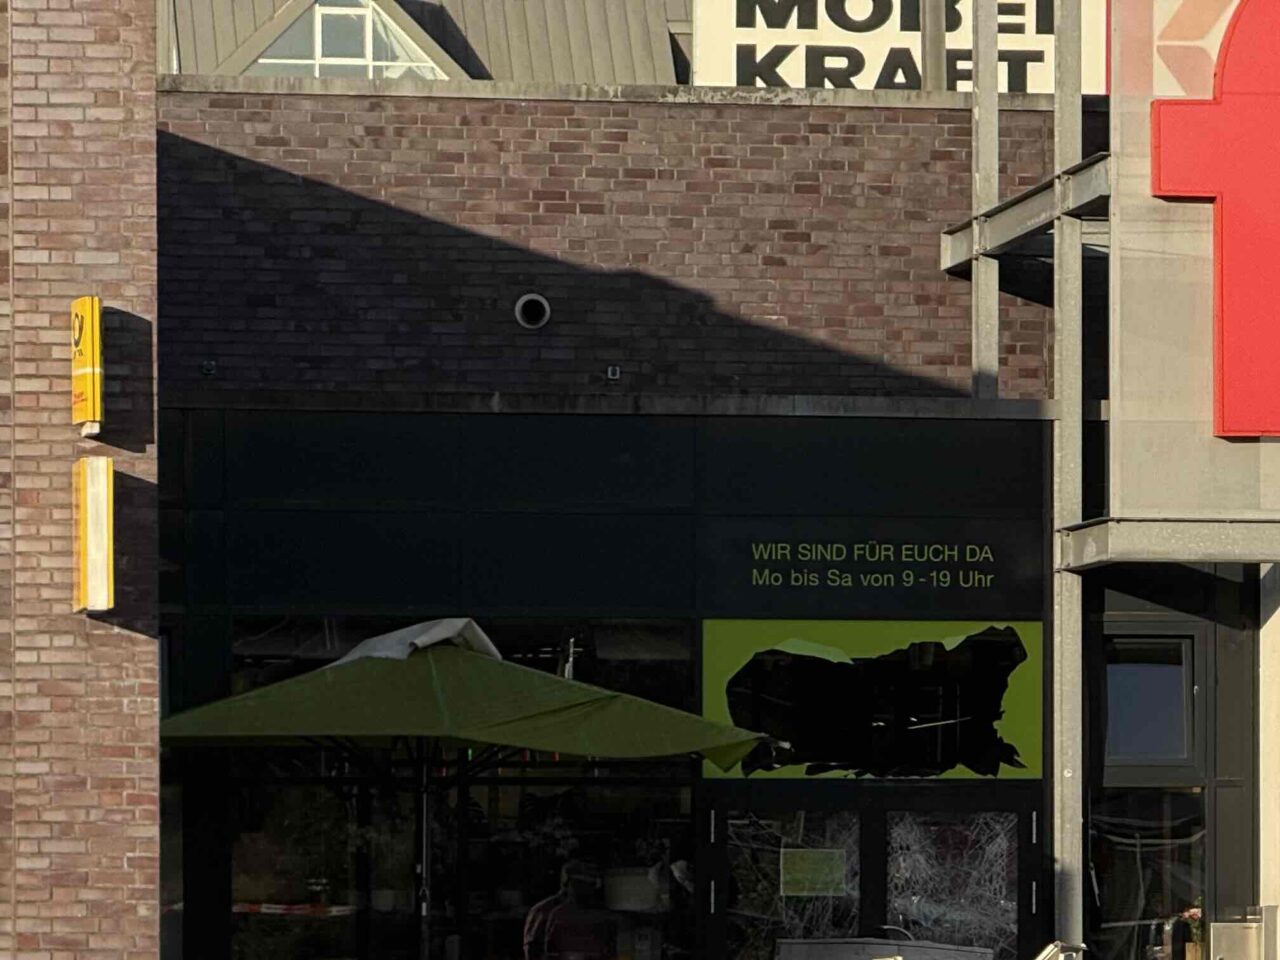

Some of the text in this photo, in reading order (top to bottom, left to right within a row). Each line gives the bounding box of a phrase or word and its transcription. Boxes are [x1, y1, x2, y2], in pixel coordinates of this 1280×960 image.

[752, 540, 994, 563] WIR SIND FÜR EUCH DA
[752, 569, 782, 586] Mo
[791, 569, 819, 587] bis
[827, 569, 852, 587] Sa
[860, 573, 894, 588] von
[959, 570, 995, 588] Uhr
